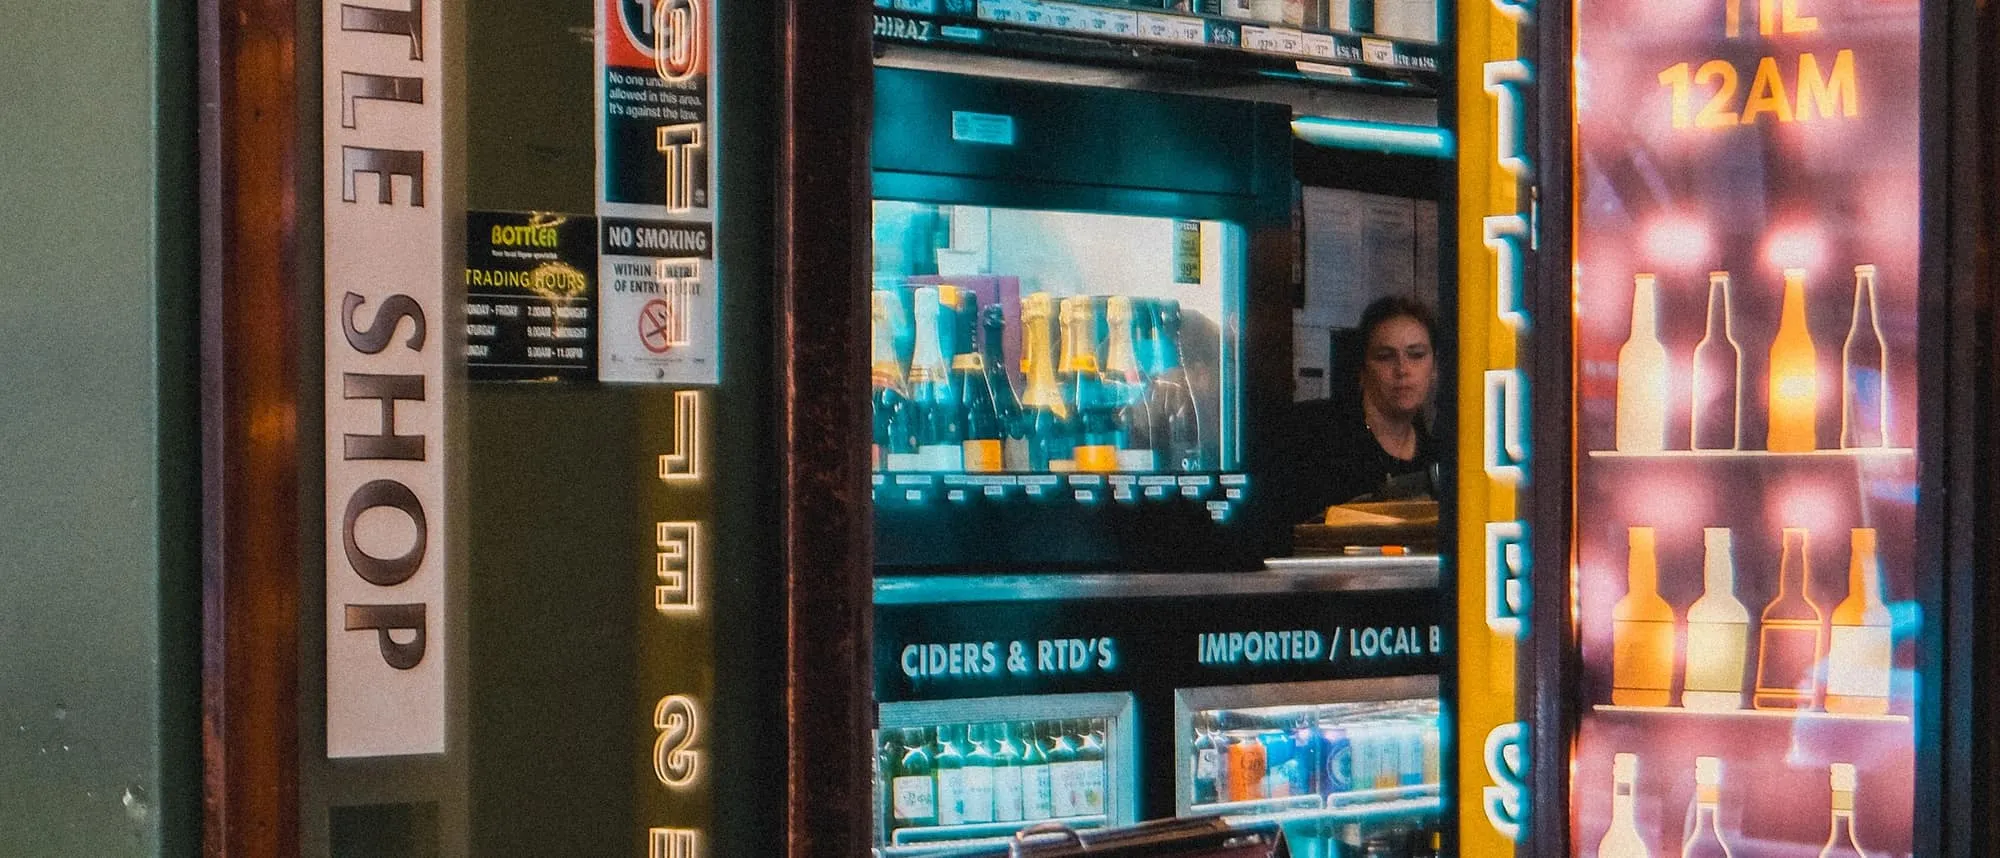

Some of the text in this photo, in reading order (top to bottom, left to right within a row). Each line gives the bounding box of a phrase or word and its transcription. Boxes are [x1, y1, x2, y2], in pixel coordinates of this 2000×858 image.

[609, 72, 623, 83] No
[626, 76, 644, 86] one
[1657, 49, 1857, 129] 12AM
[609, 89, 647, 102] allowed
[649, 92, 658, 103] in
[660, 92, 677, 104] this
[626, 106, 661, 119] against
[663, 107, 678, 119] the
[609, 226, 706, 251] NO SMOKING
[465, 269, 585, 289] TRADING HOURS
[614, 263, 651, 278] WITHIN
[614, 280, 627, 292] OF
[630, 281, 659, 295] ENTRY
[342, 291, 428, 670] SHOP
[1198, 630, 1320, 663] IMPORTED
[1328, 627, 1341, 661] /
[1350, 627, 1421, 657] LOCAL
[901, 637, 1113, 677] CIDERS & RTD'S
